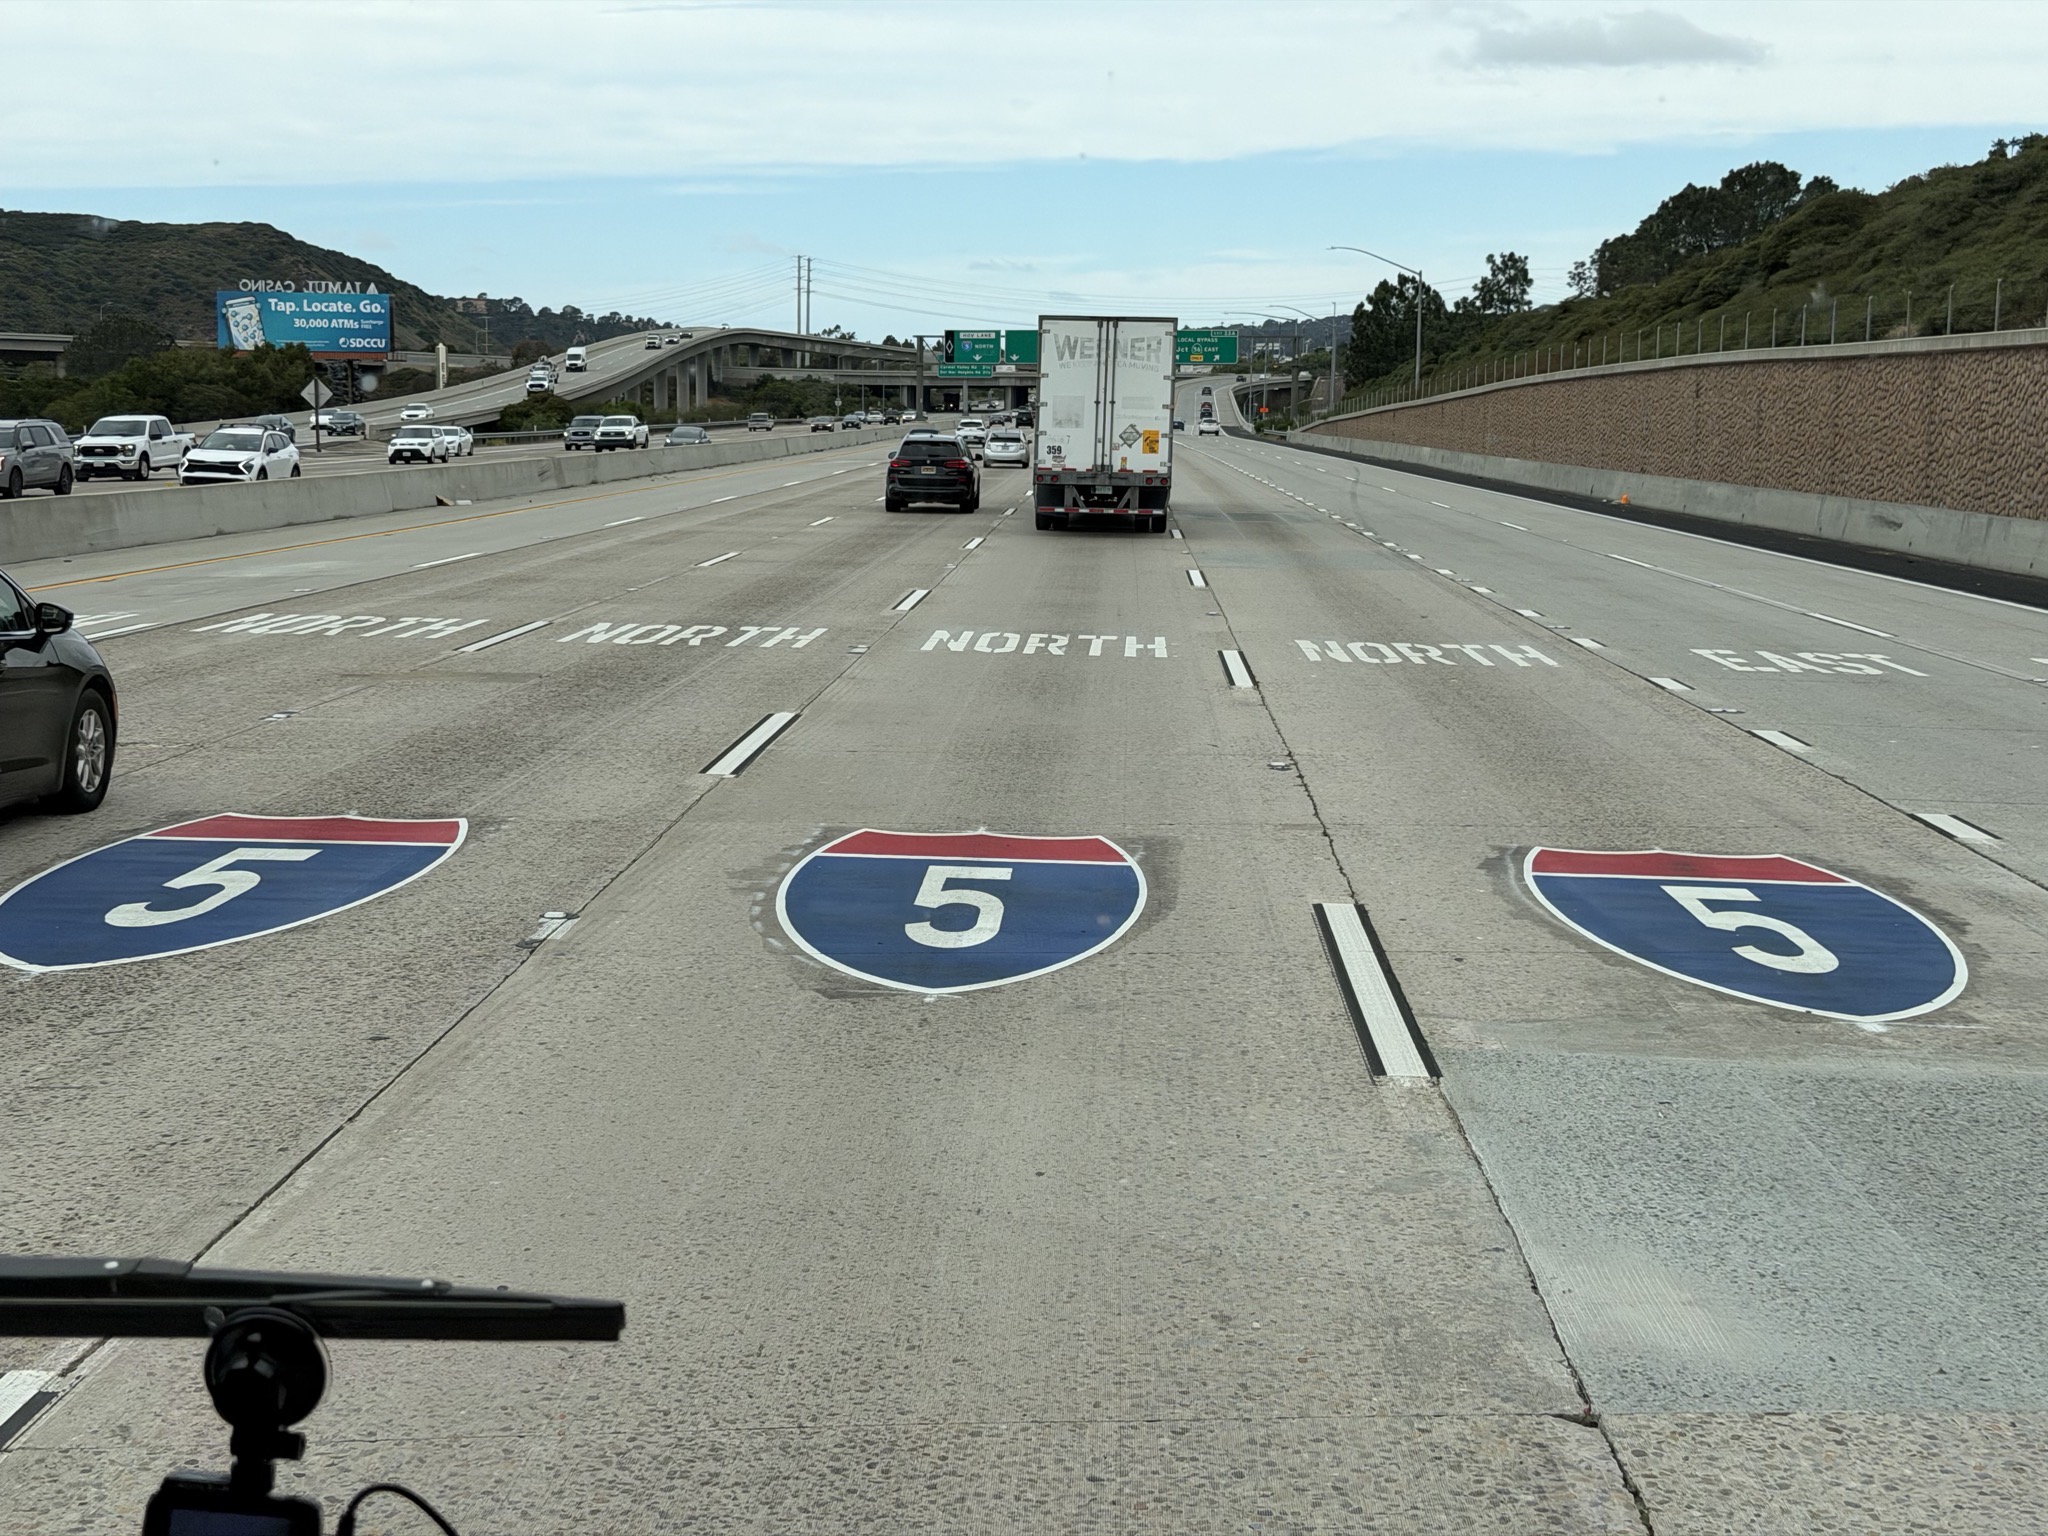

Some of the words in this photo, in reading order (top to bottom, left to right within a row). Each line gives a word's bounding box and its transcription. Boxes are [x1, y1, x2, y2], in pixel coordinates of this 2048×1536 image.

[268, 299, 299, 314] Tap.
[303, 300, 356, 313] Locate.
[359, 300, 385, 313] Go.
[293, 318, 329, 329] 30,000
[331, 318, 359, 329] ATMs
[350, 338, 386, 348] SDCCU
[1046, 445, 1062, 455] 359
[189, 613, 491, 639] NORTH
[557, 622, 829, 648] NORTH
[920, 630, 1169, 658] NORTH
[1294, 639, 1560, 667] NORTH
[1689, 648, 1931, 677] EAST
[104, 847, 325, 928] 5
[905, 865, 1014, 949] 5
[1659, 885, 1840, 974] 5
